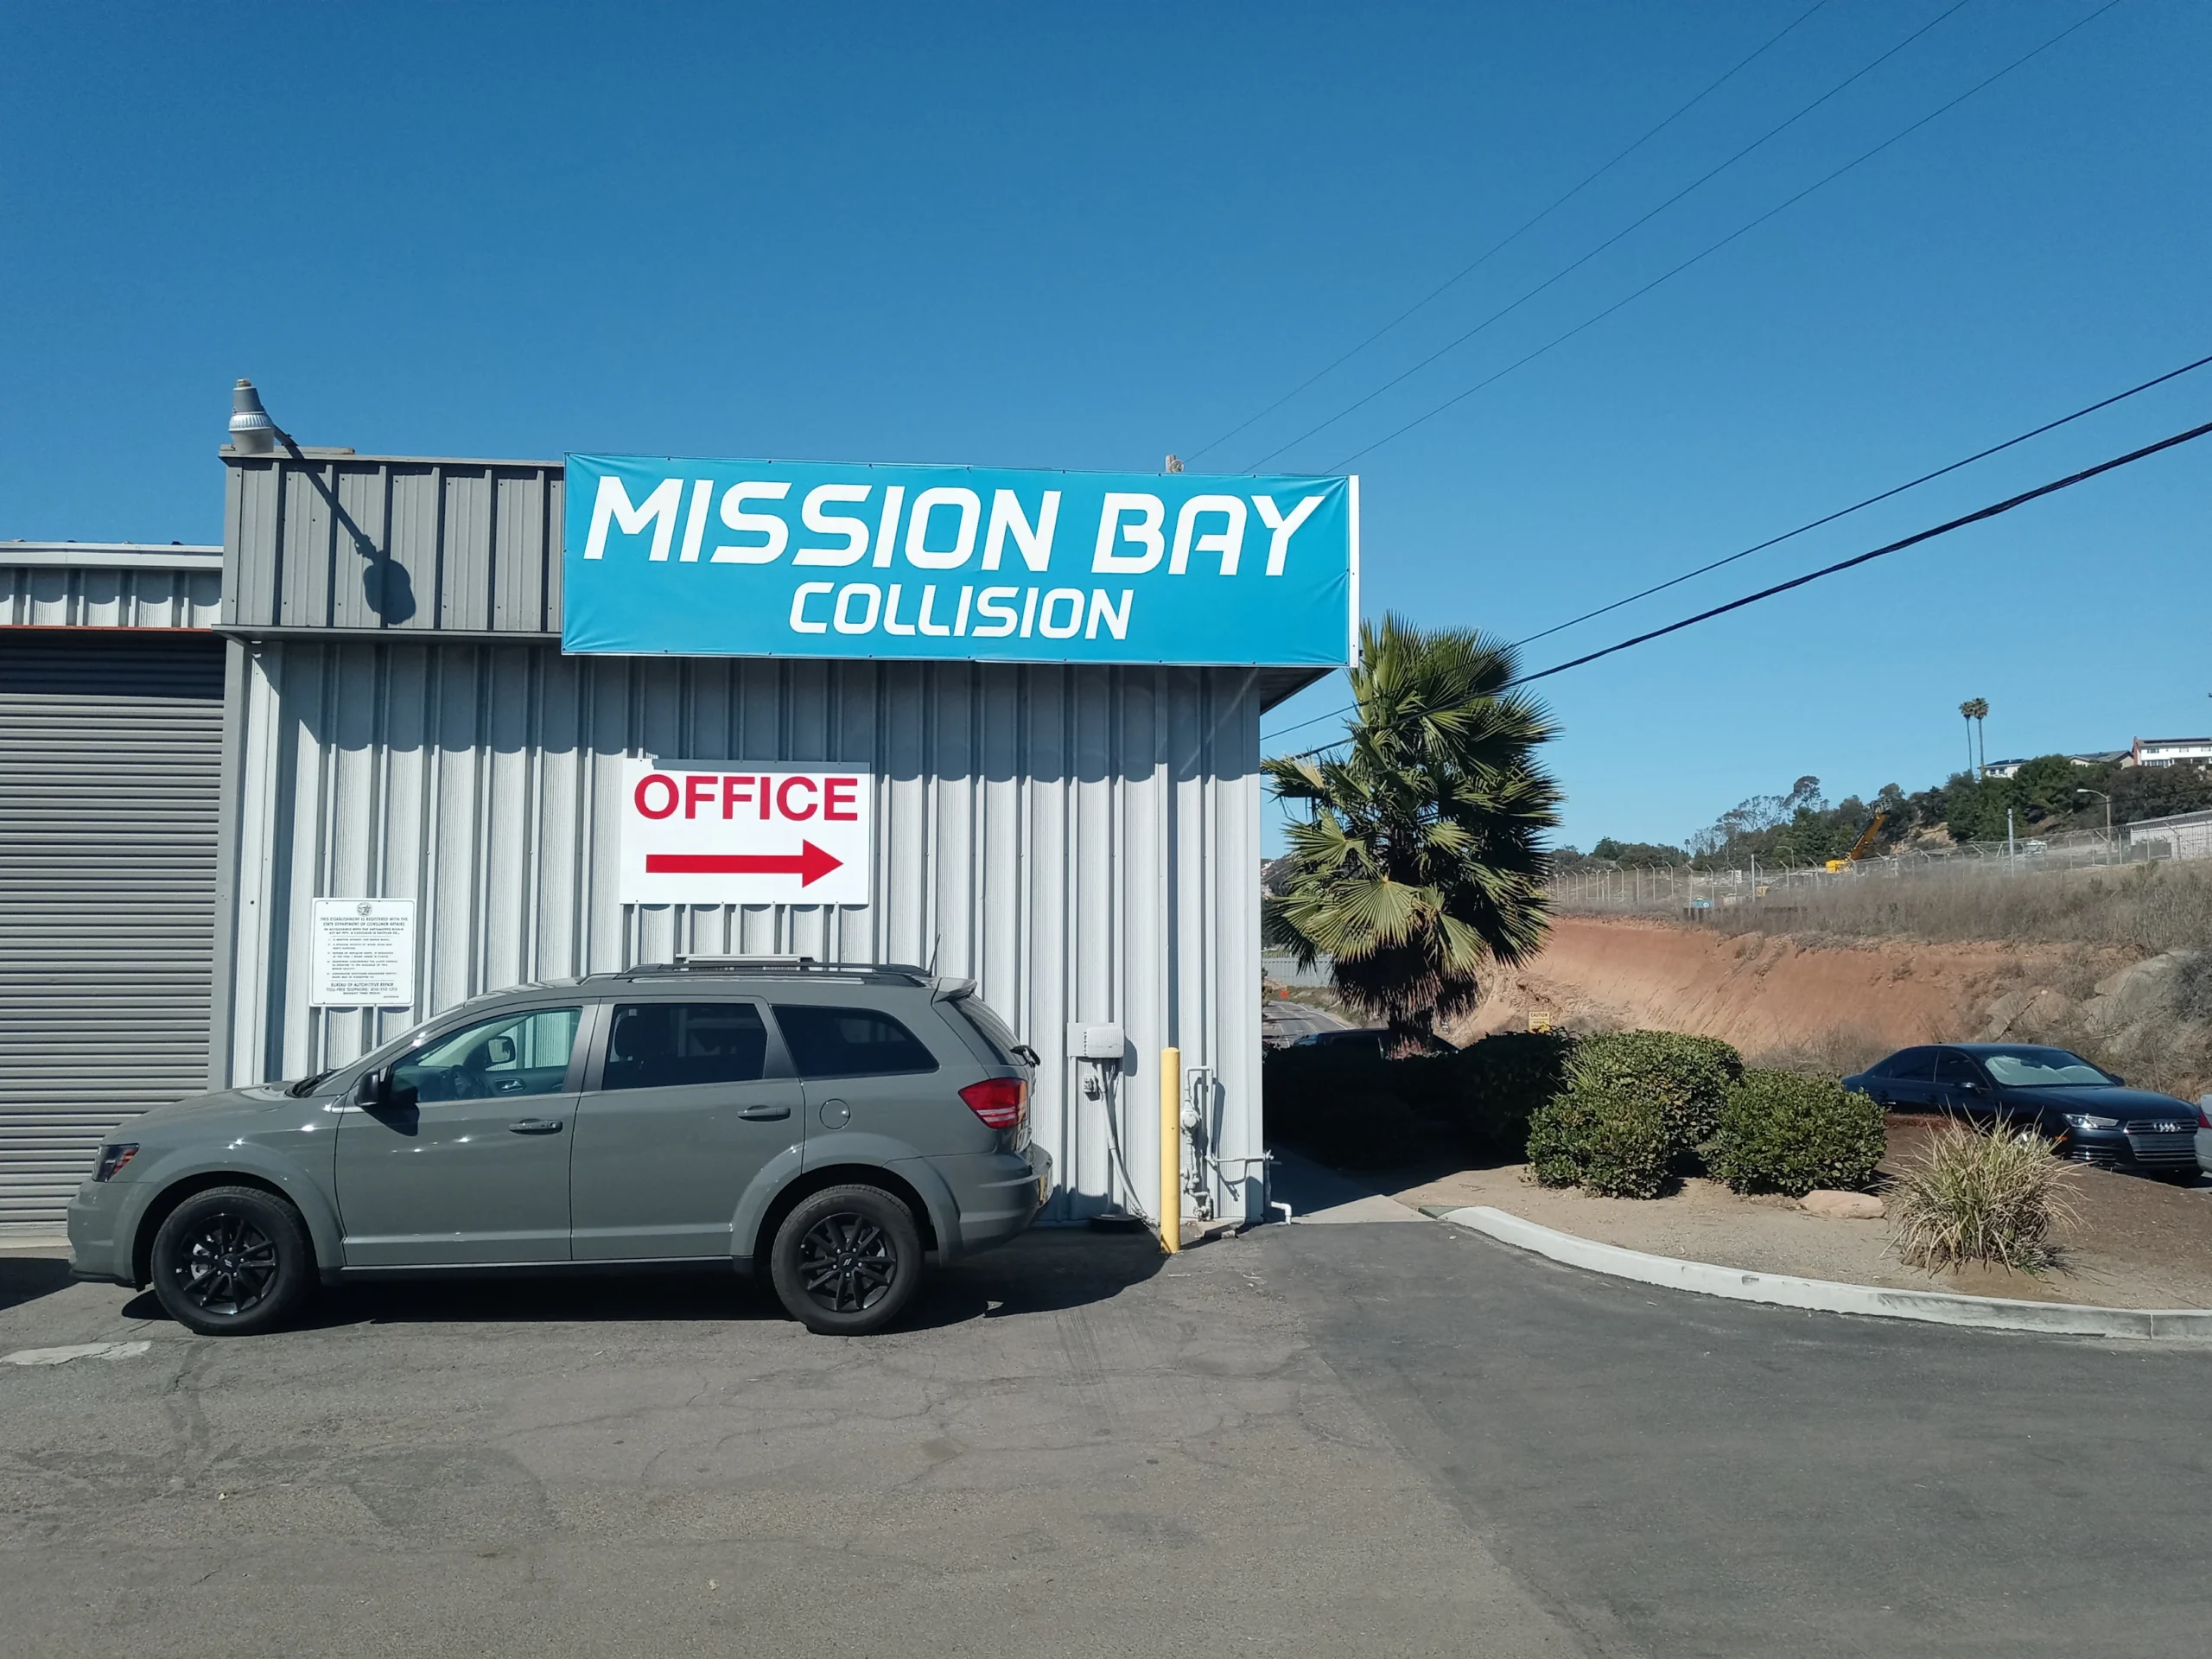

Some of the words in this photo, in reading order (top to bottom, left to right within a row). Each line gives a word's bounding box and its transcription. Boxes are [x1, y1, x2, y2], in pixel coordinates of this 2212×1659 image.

[585, 477, 1060, 570] MISSION
[1092, 493, 1324, 575] BAY
[790, 582, 1133, 639] COLLISION
[634, 774, 858, 821] OFFICE
